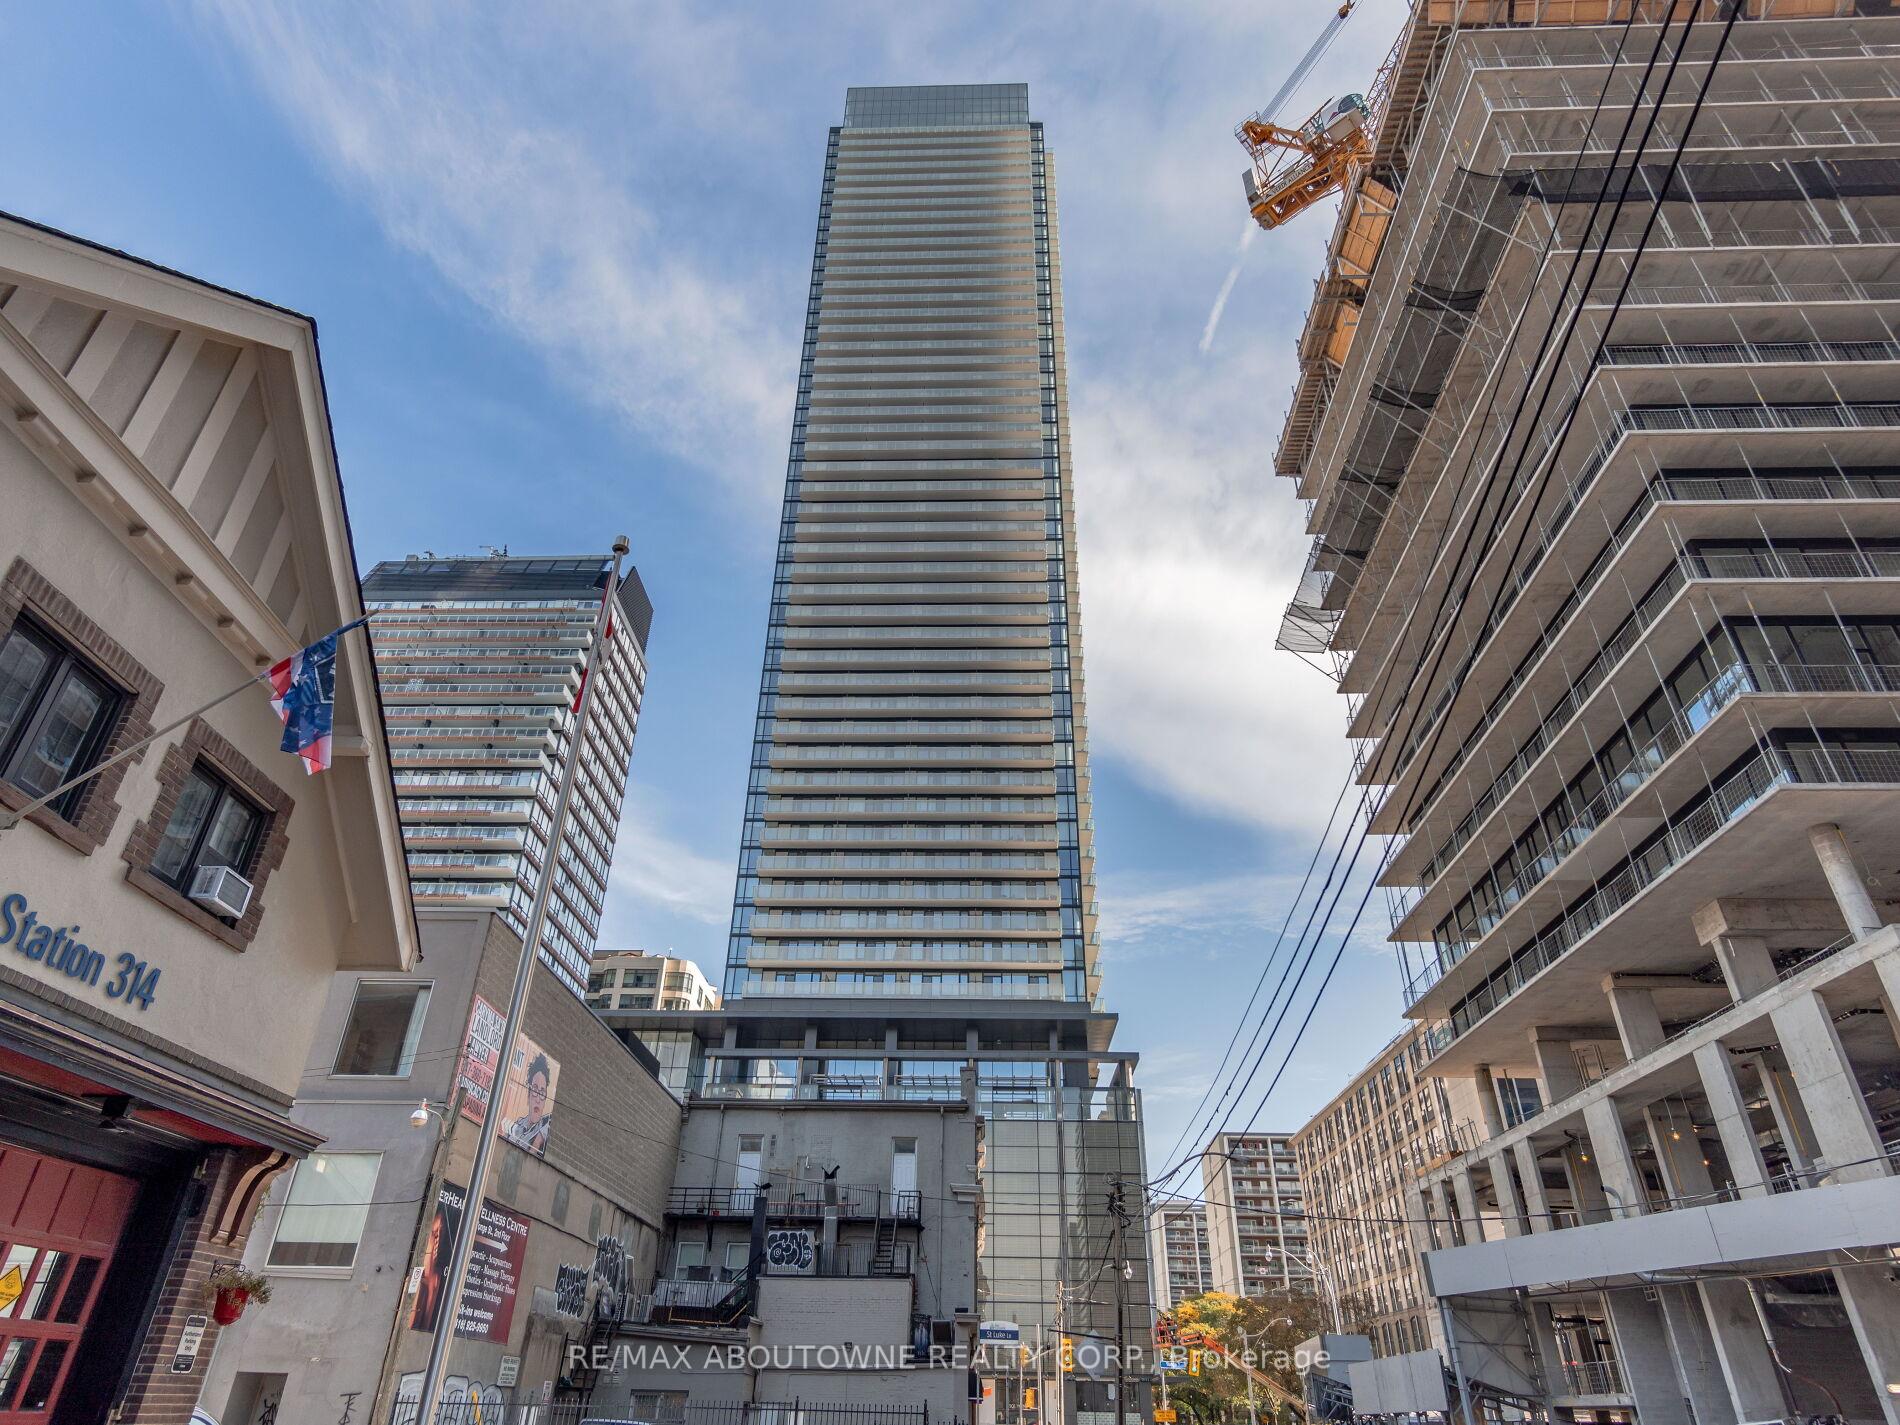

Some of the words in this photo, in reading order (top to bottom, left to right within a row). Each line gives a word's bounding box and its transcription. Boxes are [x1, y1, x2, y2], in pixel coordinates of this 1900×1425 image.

[0, 893, 106, 987] Station
[107, 952, 162, 1011] 314
[471, 1015, 503, 1052] LANDLORD
[480, 1206, 506, 1227] ELLNESS
[507, 1217, 528, 1236] CENTRE
[473, 1308, 494, 1320] welcome
